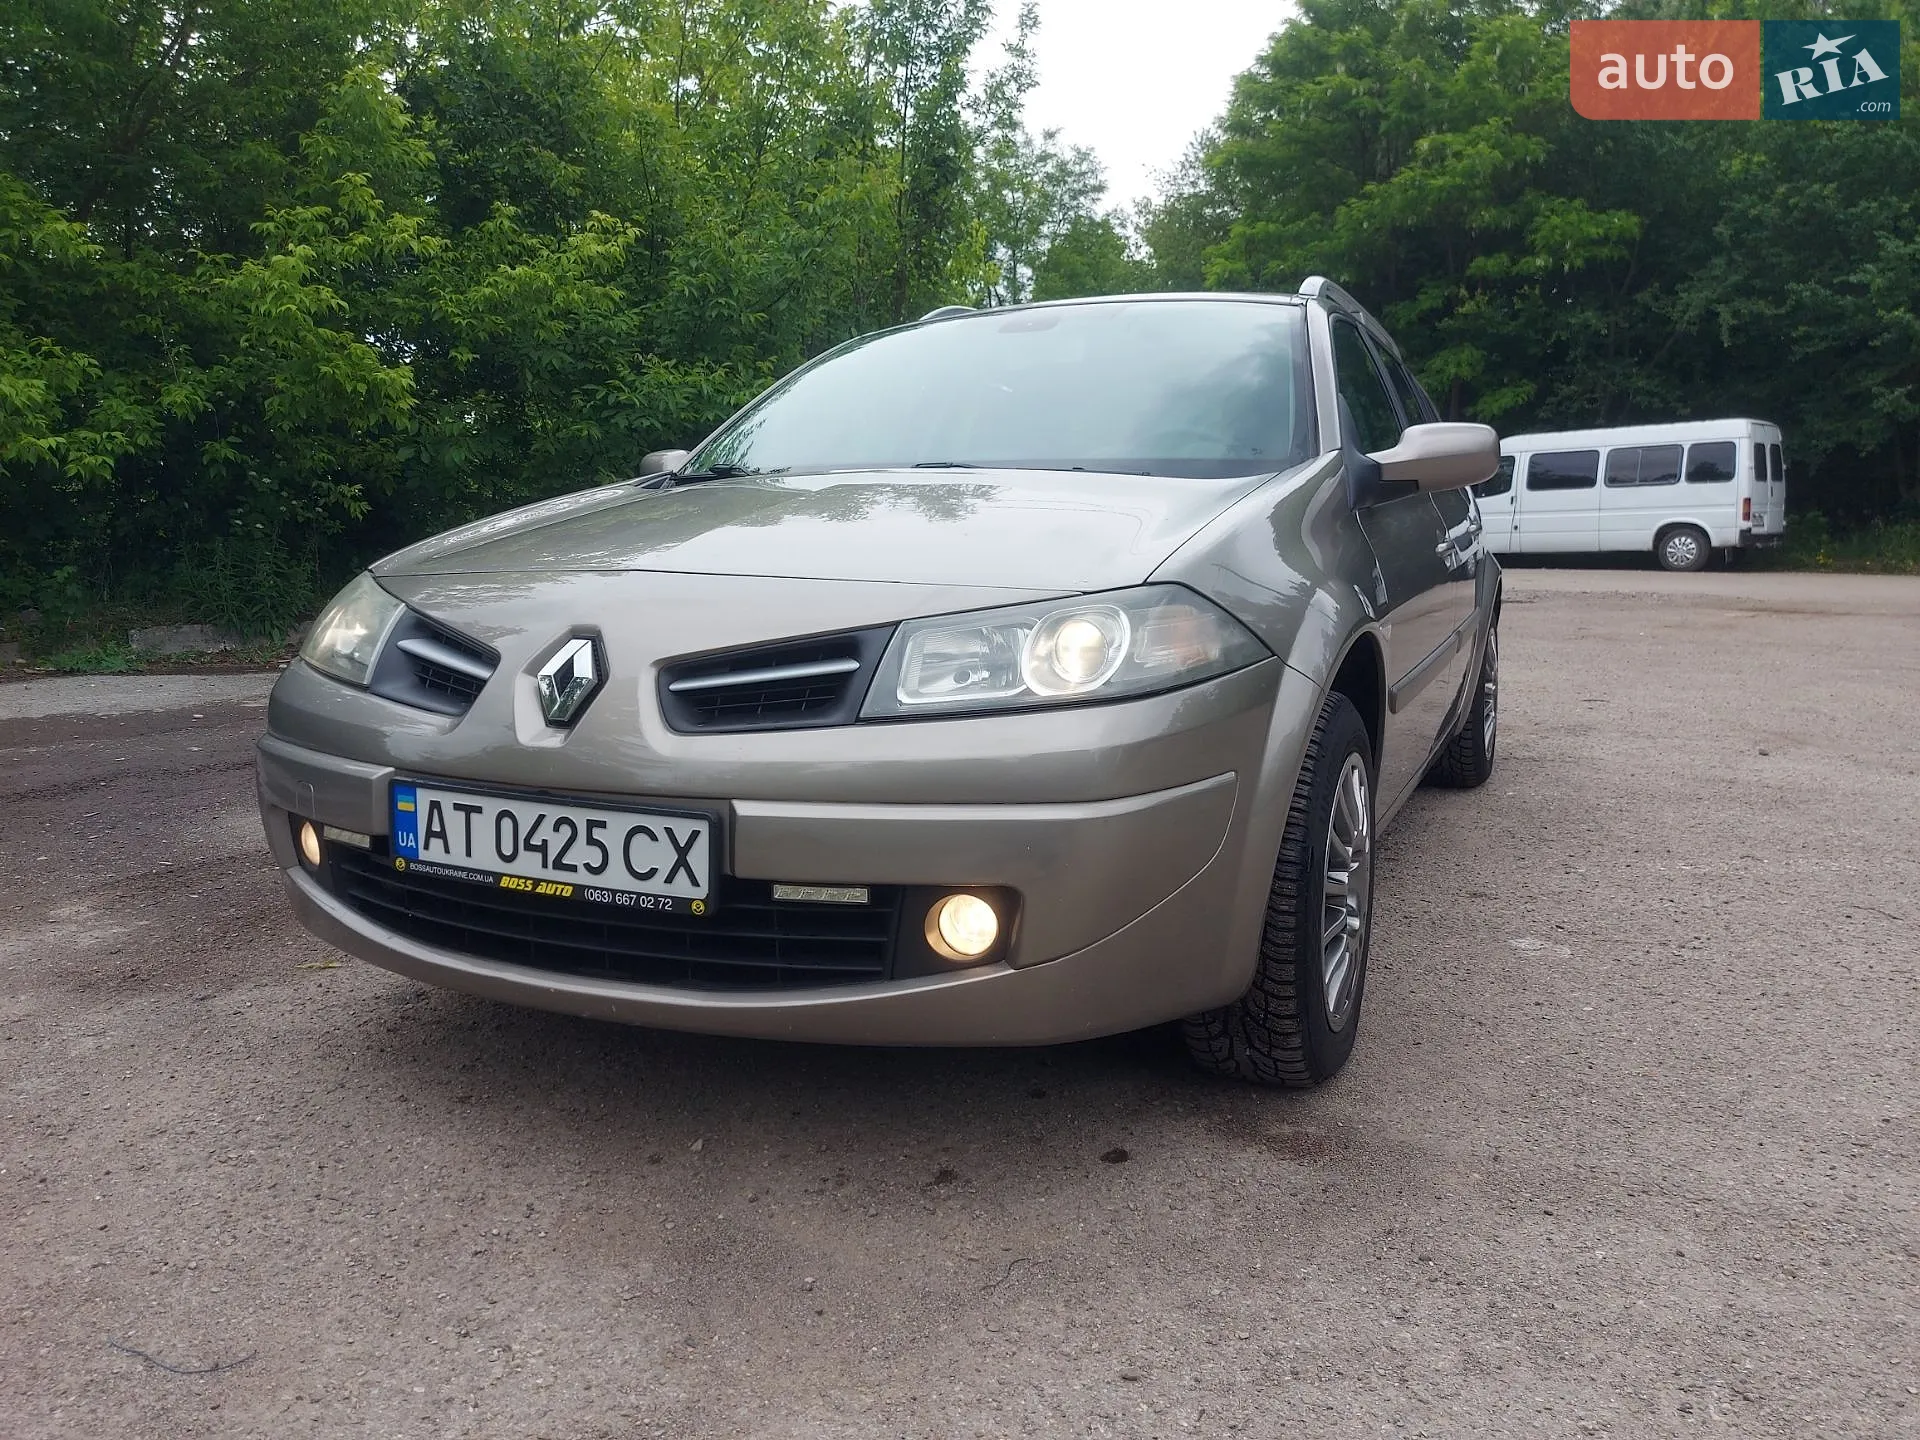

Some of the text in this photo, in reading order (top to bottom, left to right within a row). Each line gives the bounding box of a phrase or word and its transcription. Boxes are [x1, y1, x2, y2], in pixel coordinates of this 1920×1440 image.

[398, 831, 416, 849] UA
[423, 800, 701, 887] AT 0425 CX
[500, 876, 574, 897] BOSS AUTO
[584, 889, 673, 911] (063) 667 02 72
